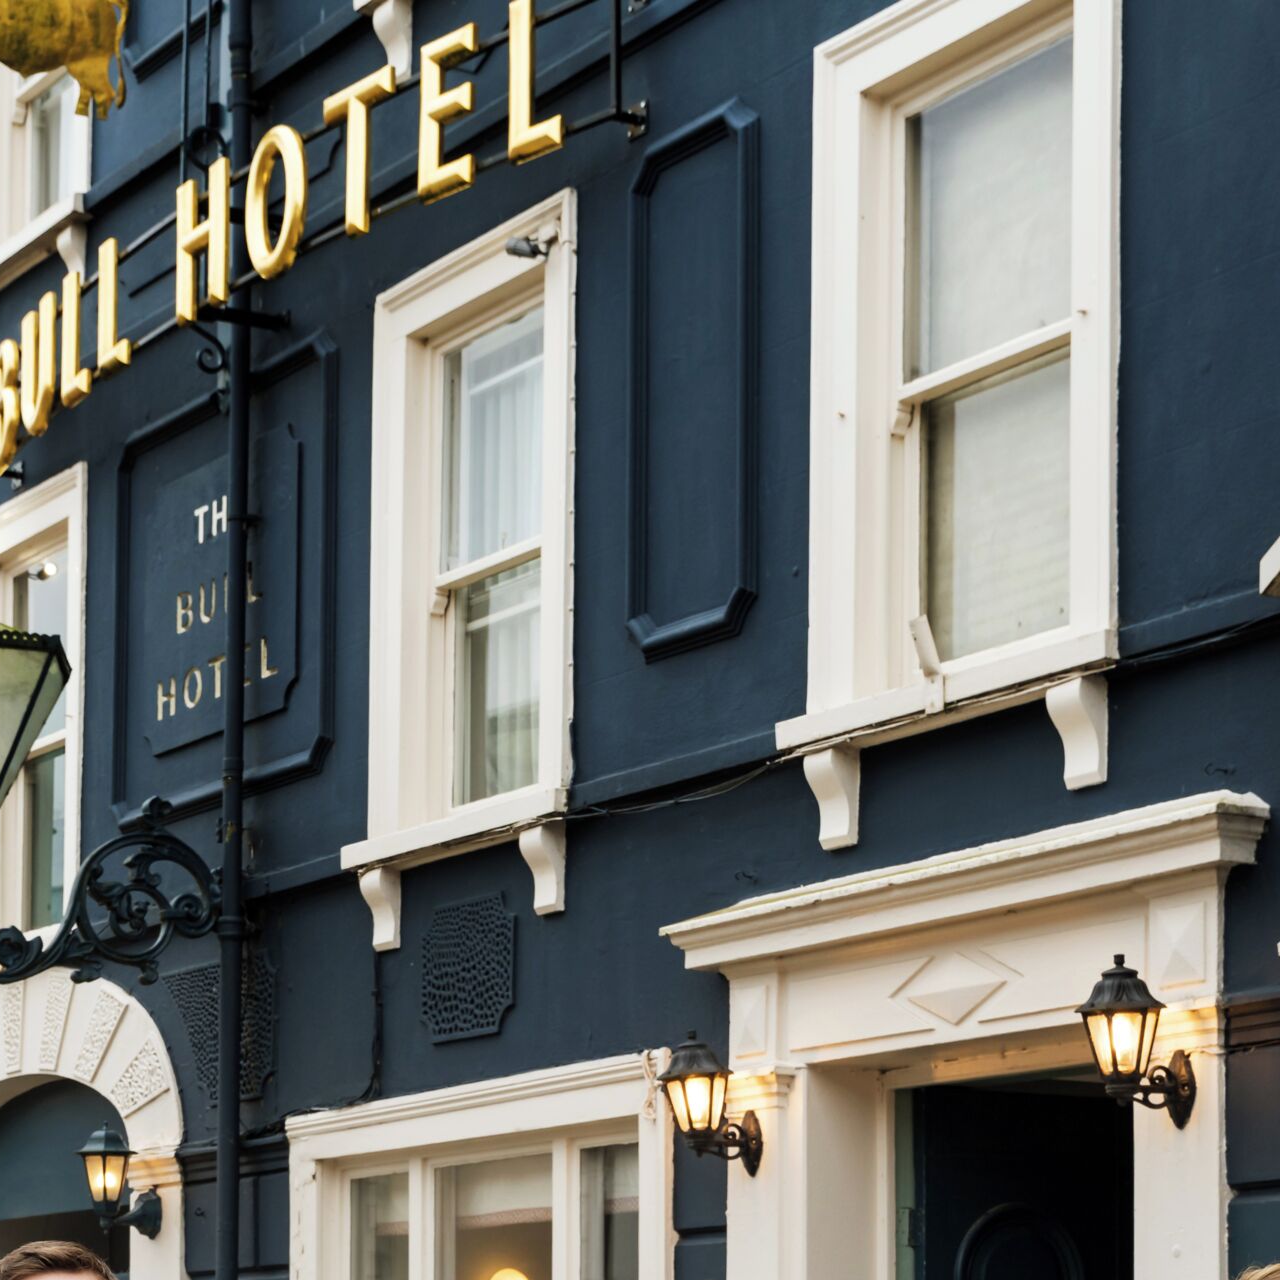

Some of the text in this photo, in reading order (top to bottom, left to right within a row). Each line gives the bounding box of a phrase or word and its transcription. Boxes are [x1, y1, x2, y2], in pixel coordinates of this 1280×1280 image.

[176, 0, 563, 325] HOTEL
[194, 495, 227, 544] TH
[157, 636, 278, 721] HOTL
